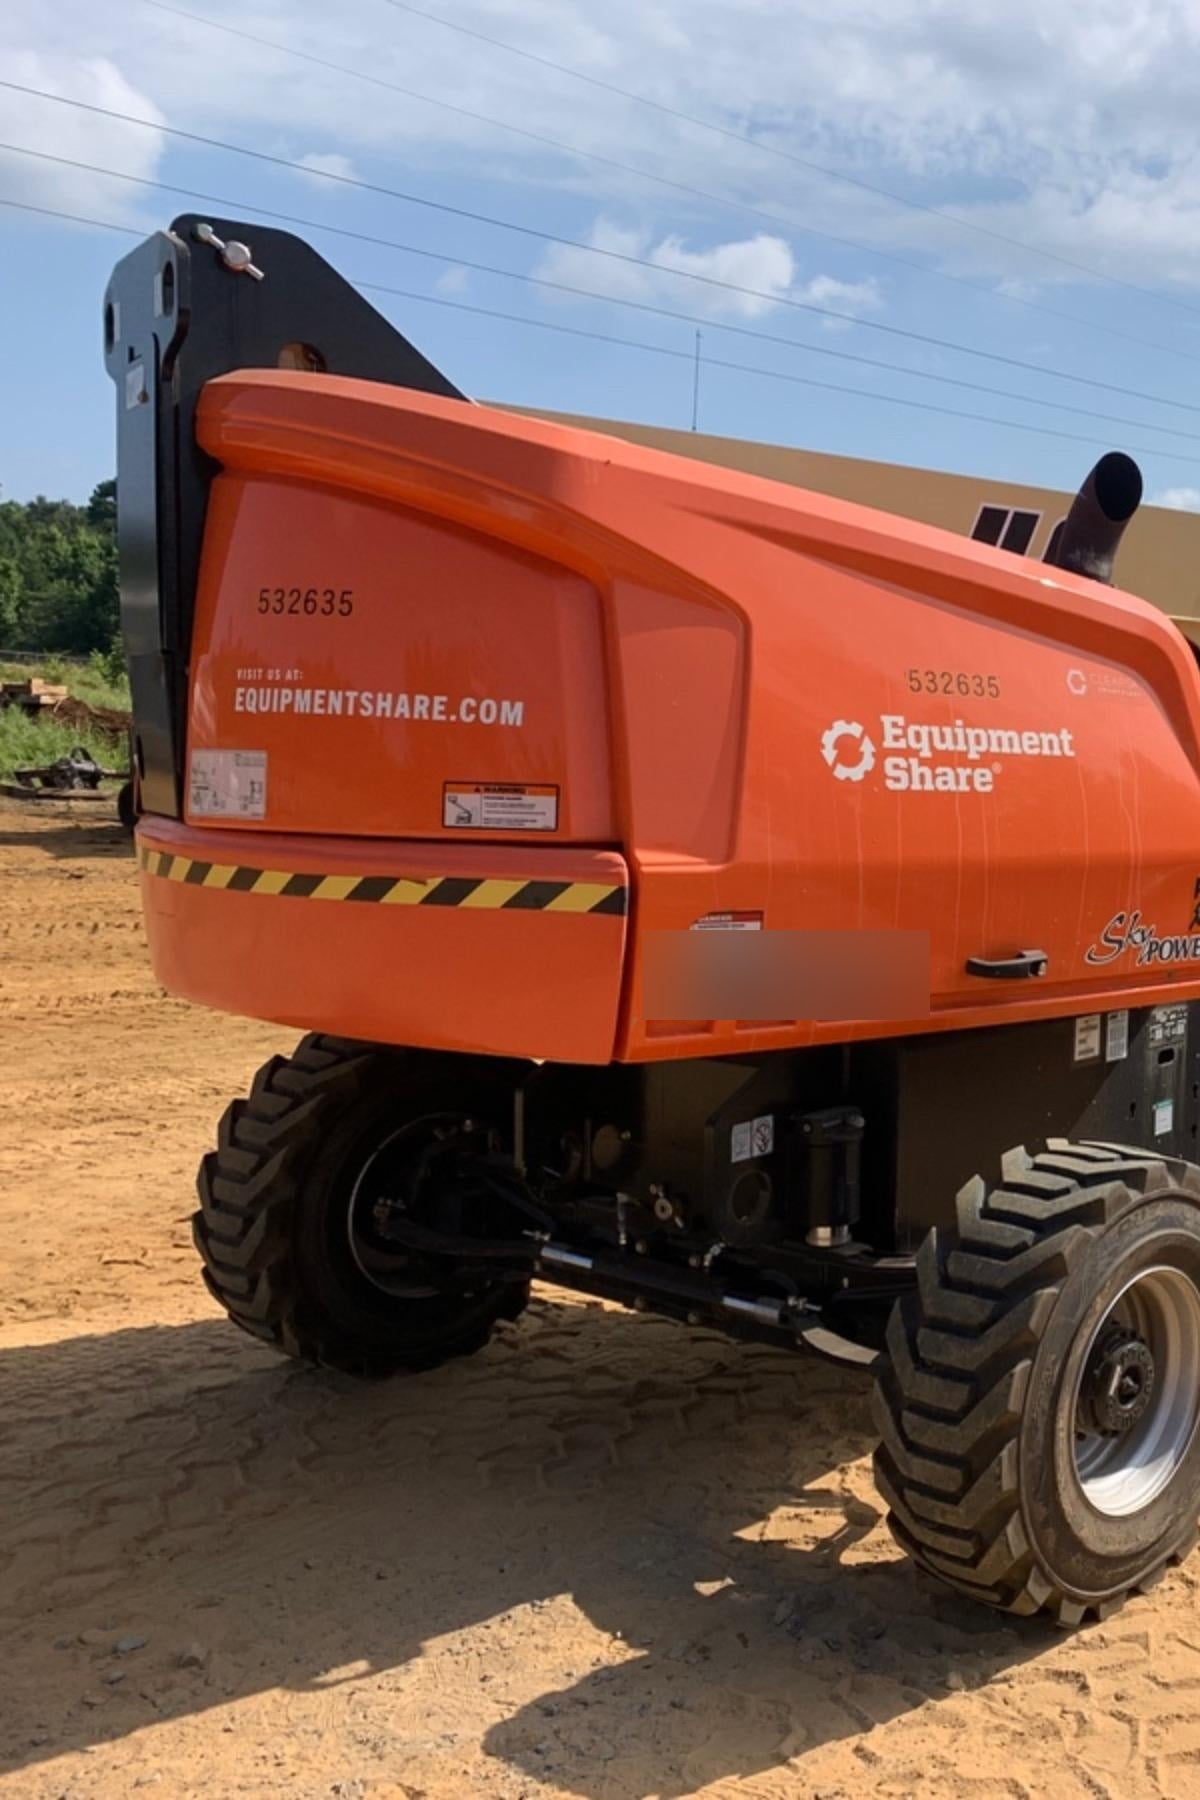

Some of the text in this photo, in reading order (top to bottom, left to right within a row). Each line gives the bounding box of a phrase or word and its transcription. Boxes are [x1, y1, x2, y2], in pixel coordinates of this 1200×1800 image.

[257, 587, 353, 617] 532635
[236, 667, 263, 681] VISIT
[267, 668, 280, 681] US
[907, 668, 1000, 699] 532635
[234, 687, 524, 727] EQUIPMENTSHARE.COM
[880, 714, 1076, 760] Equipment
